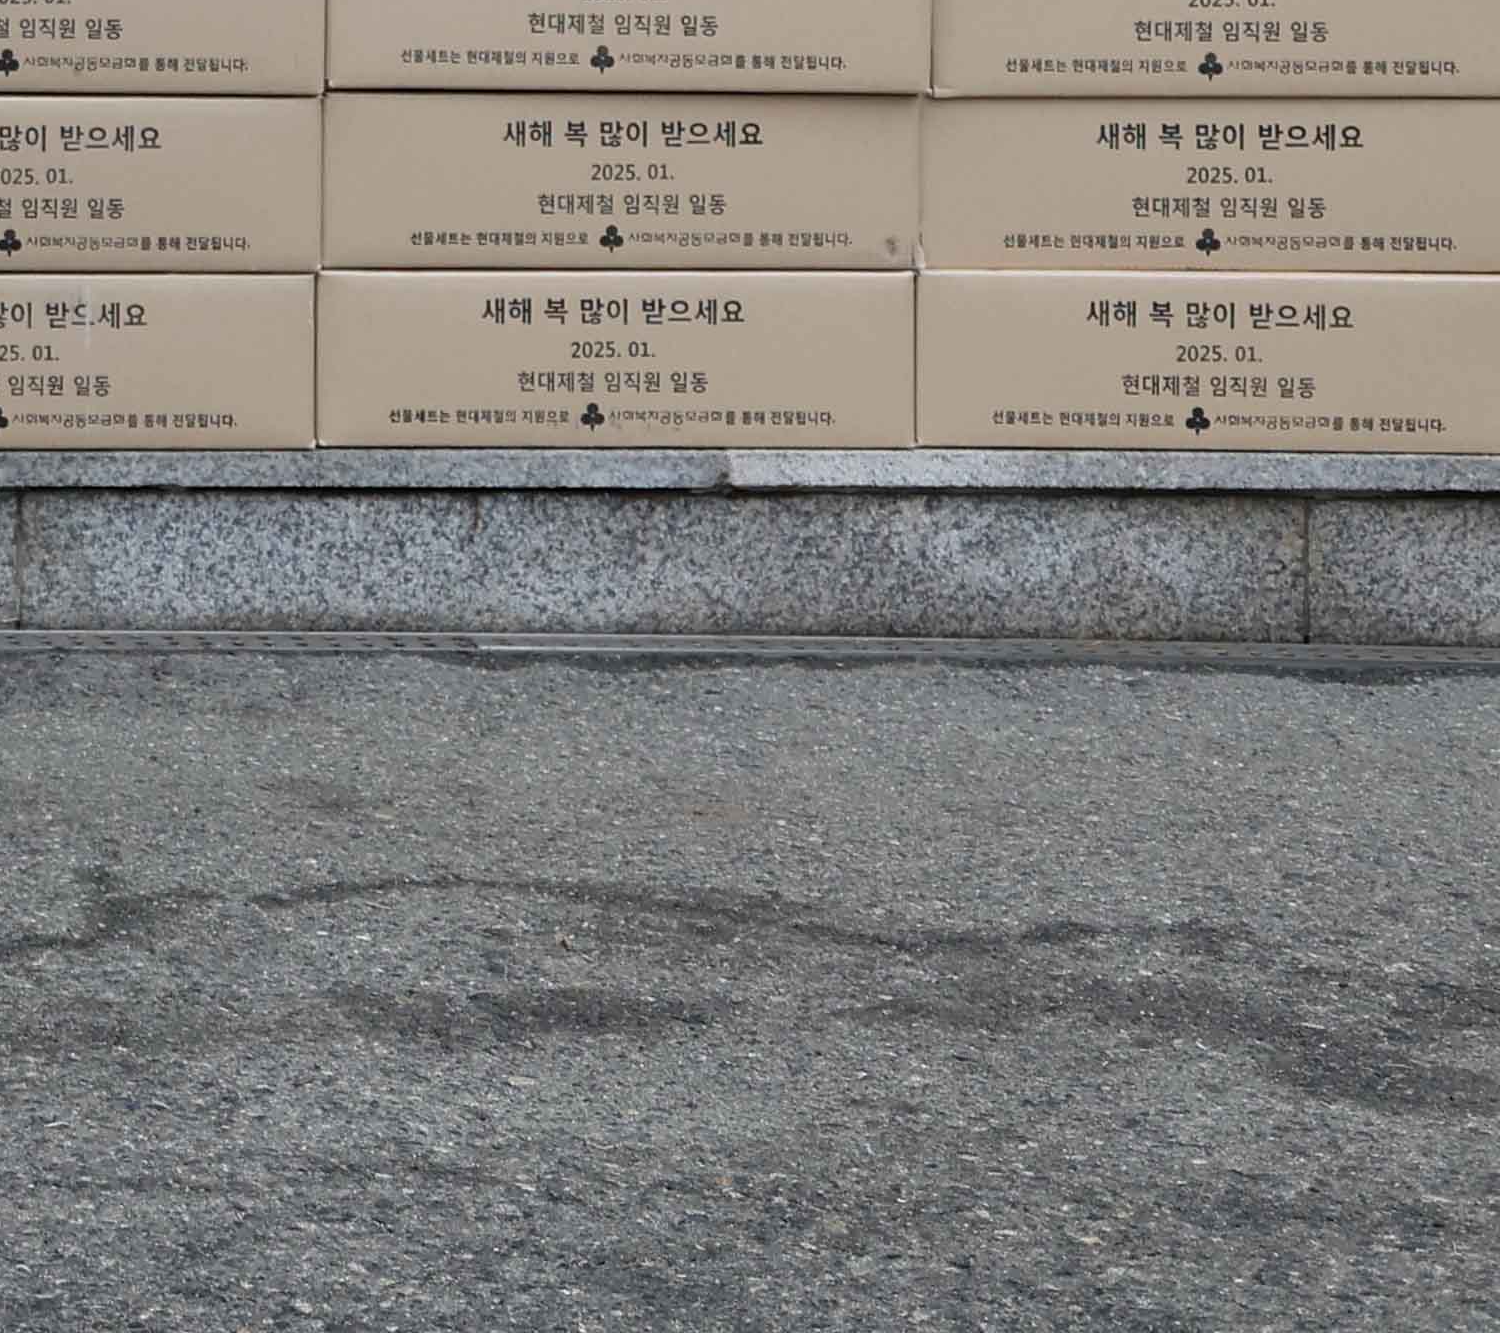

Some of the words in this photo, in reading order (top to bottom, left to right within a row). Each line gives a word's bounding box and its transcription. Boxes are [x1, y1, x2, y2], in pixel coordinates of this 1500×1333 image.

[528, 13, 604, 35] 현대제철
[614, 13, 671, 37] 임직원
[680, 15, 718, 37] 일동
[401, 49, 461, 64] 선물세트는
[466, 50, 527, 66] 현대제철의
[532, 50, 580, 66] 지원으로
[752, 54, 775, 69] 통해
[780, 55, 847, 72] 전달됩니다.
